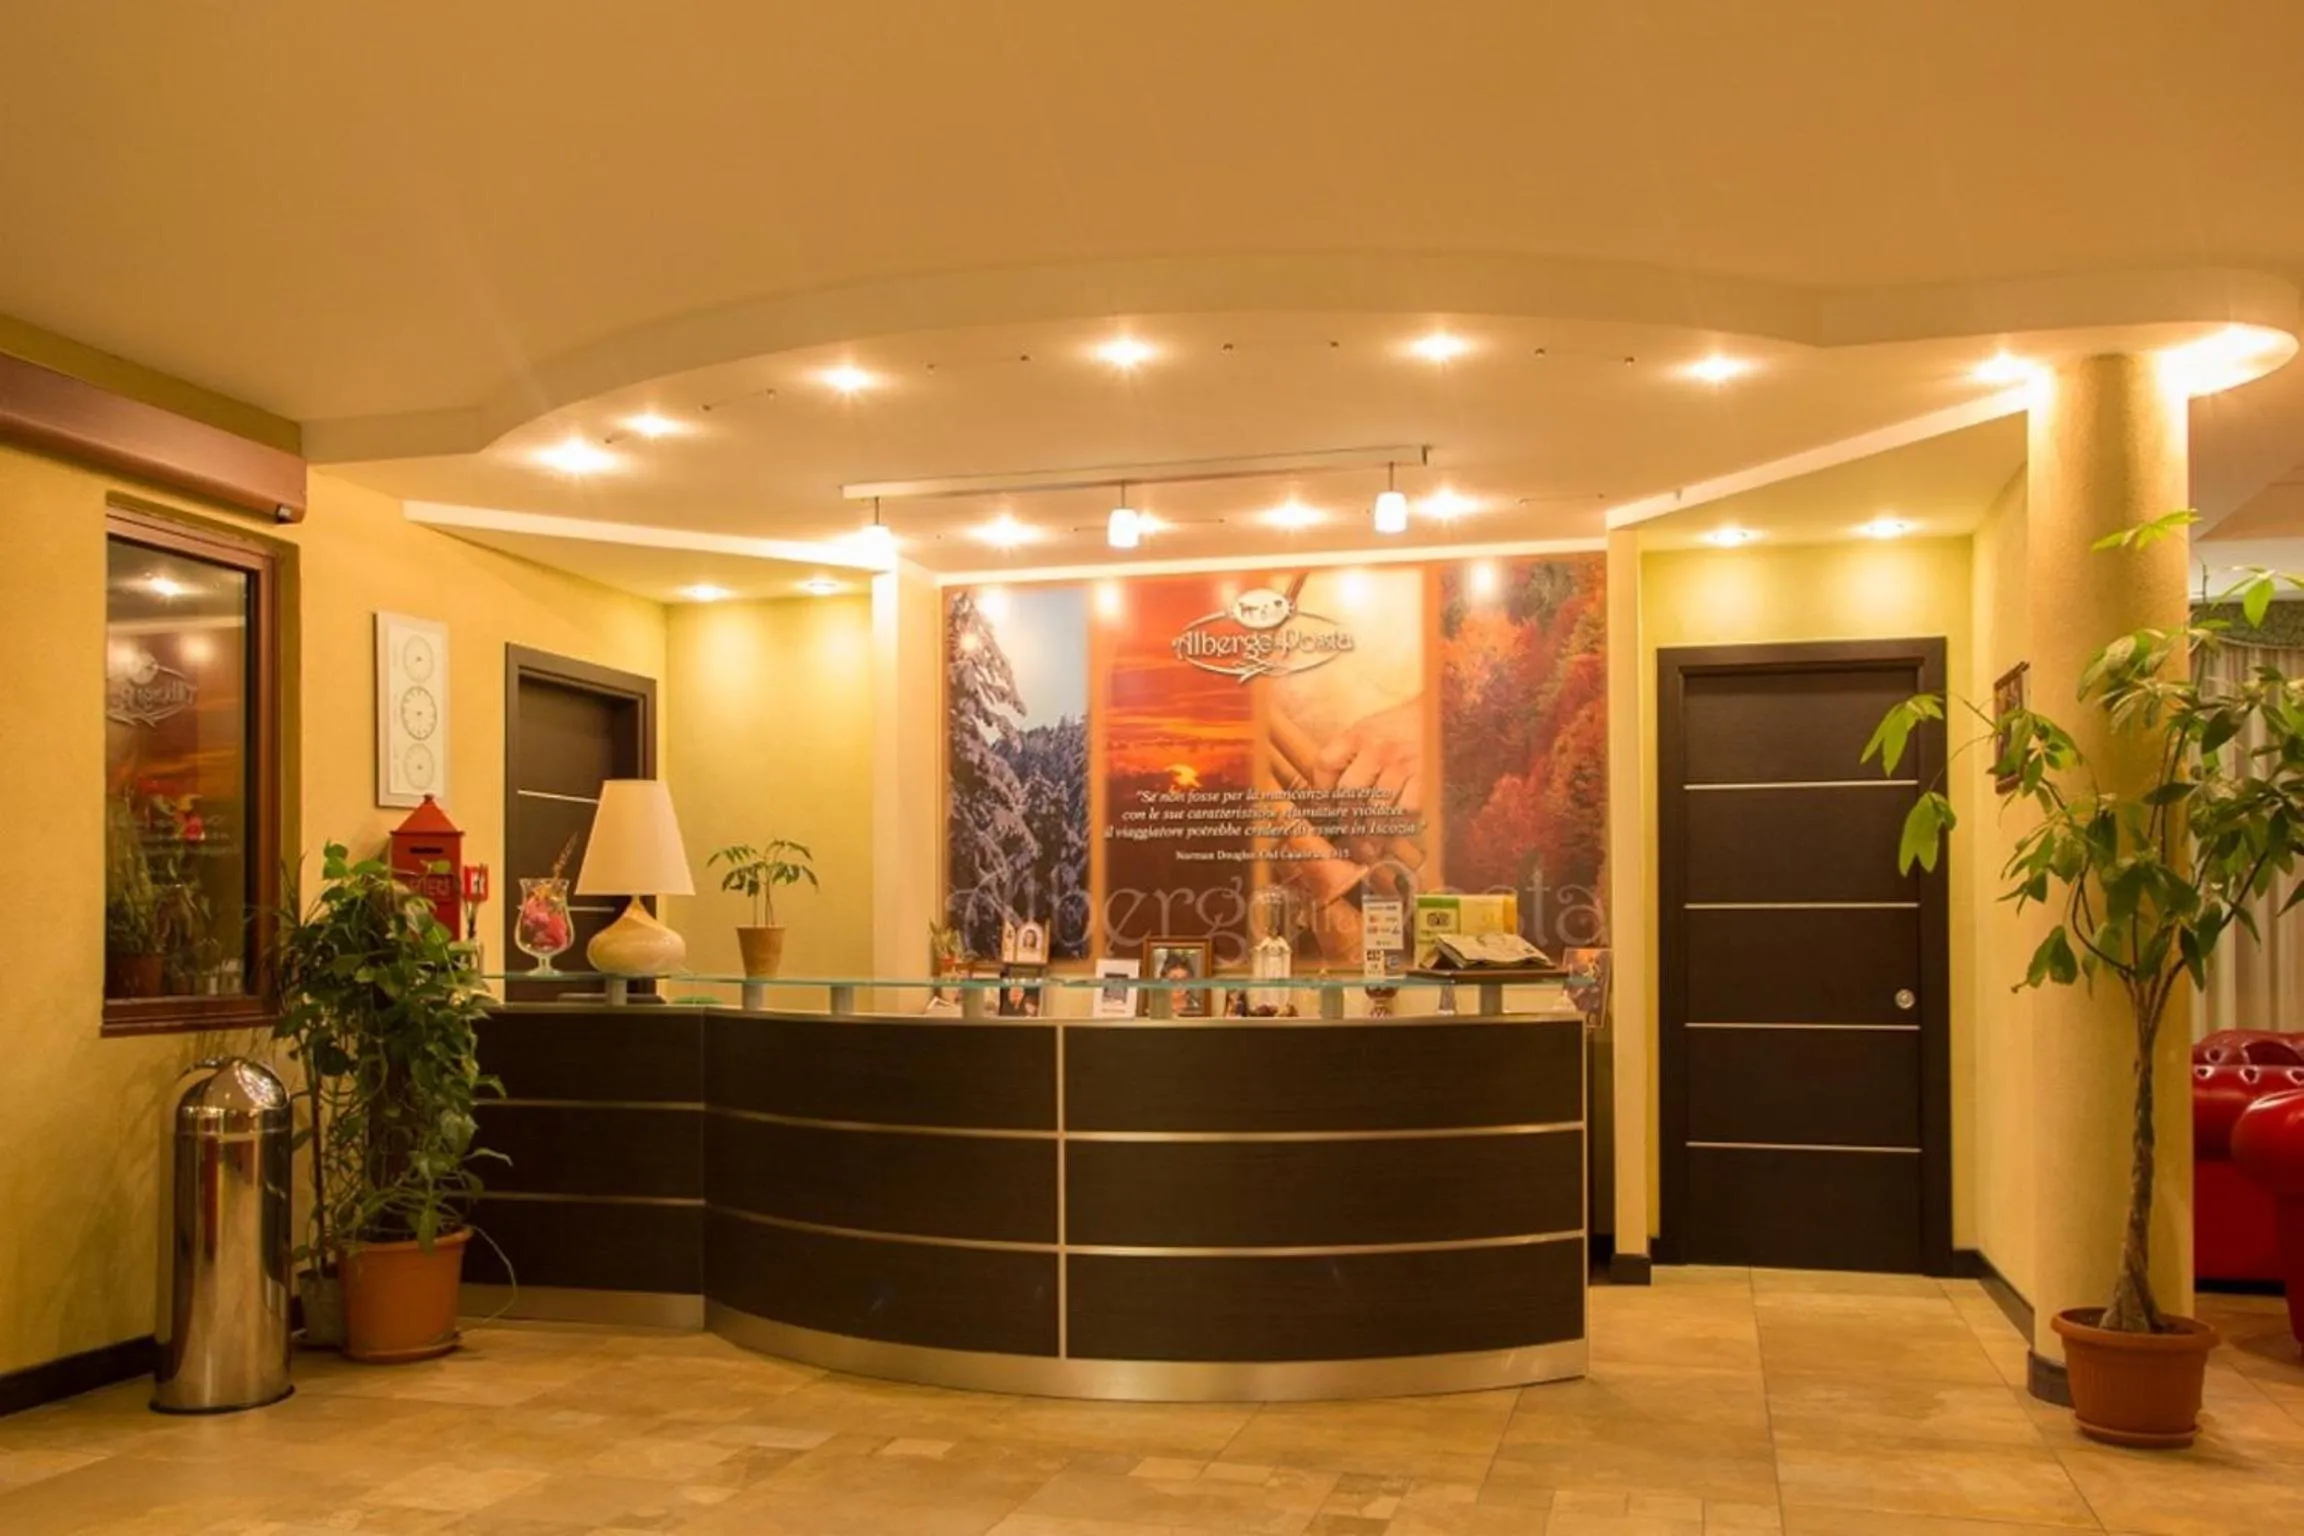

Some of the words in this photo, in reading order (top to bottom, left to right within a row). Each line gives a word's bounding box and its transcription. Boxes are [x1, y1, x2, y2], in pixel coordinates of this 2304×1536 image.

[1171, 629, 1273, 659] Albergo
[1187, 789, 1220, 804] fosse
[1222, 791, 1243, 803] per
[1122, 810, 1146, 821] con
[1149, 807, 1160, 820] le
[1163, 809, 1185, 820] sue
[1115, 825, 1184, 840] viaggiatore
[1186, 822, 1241, 839] potrebbe
[1352, 821, 1366, 835] in
